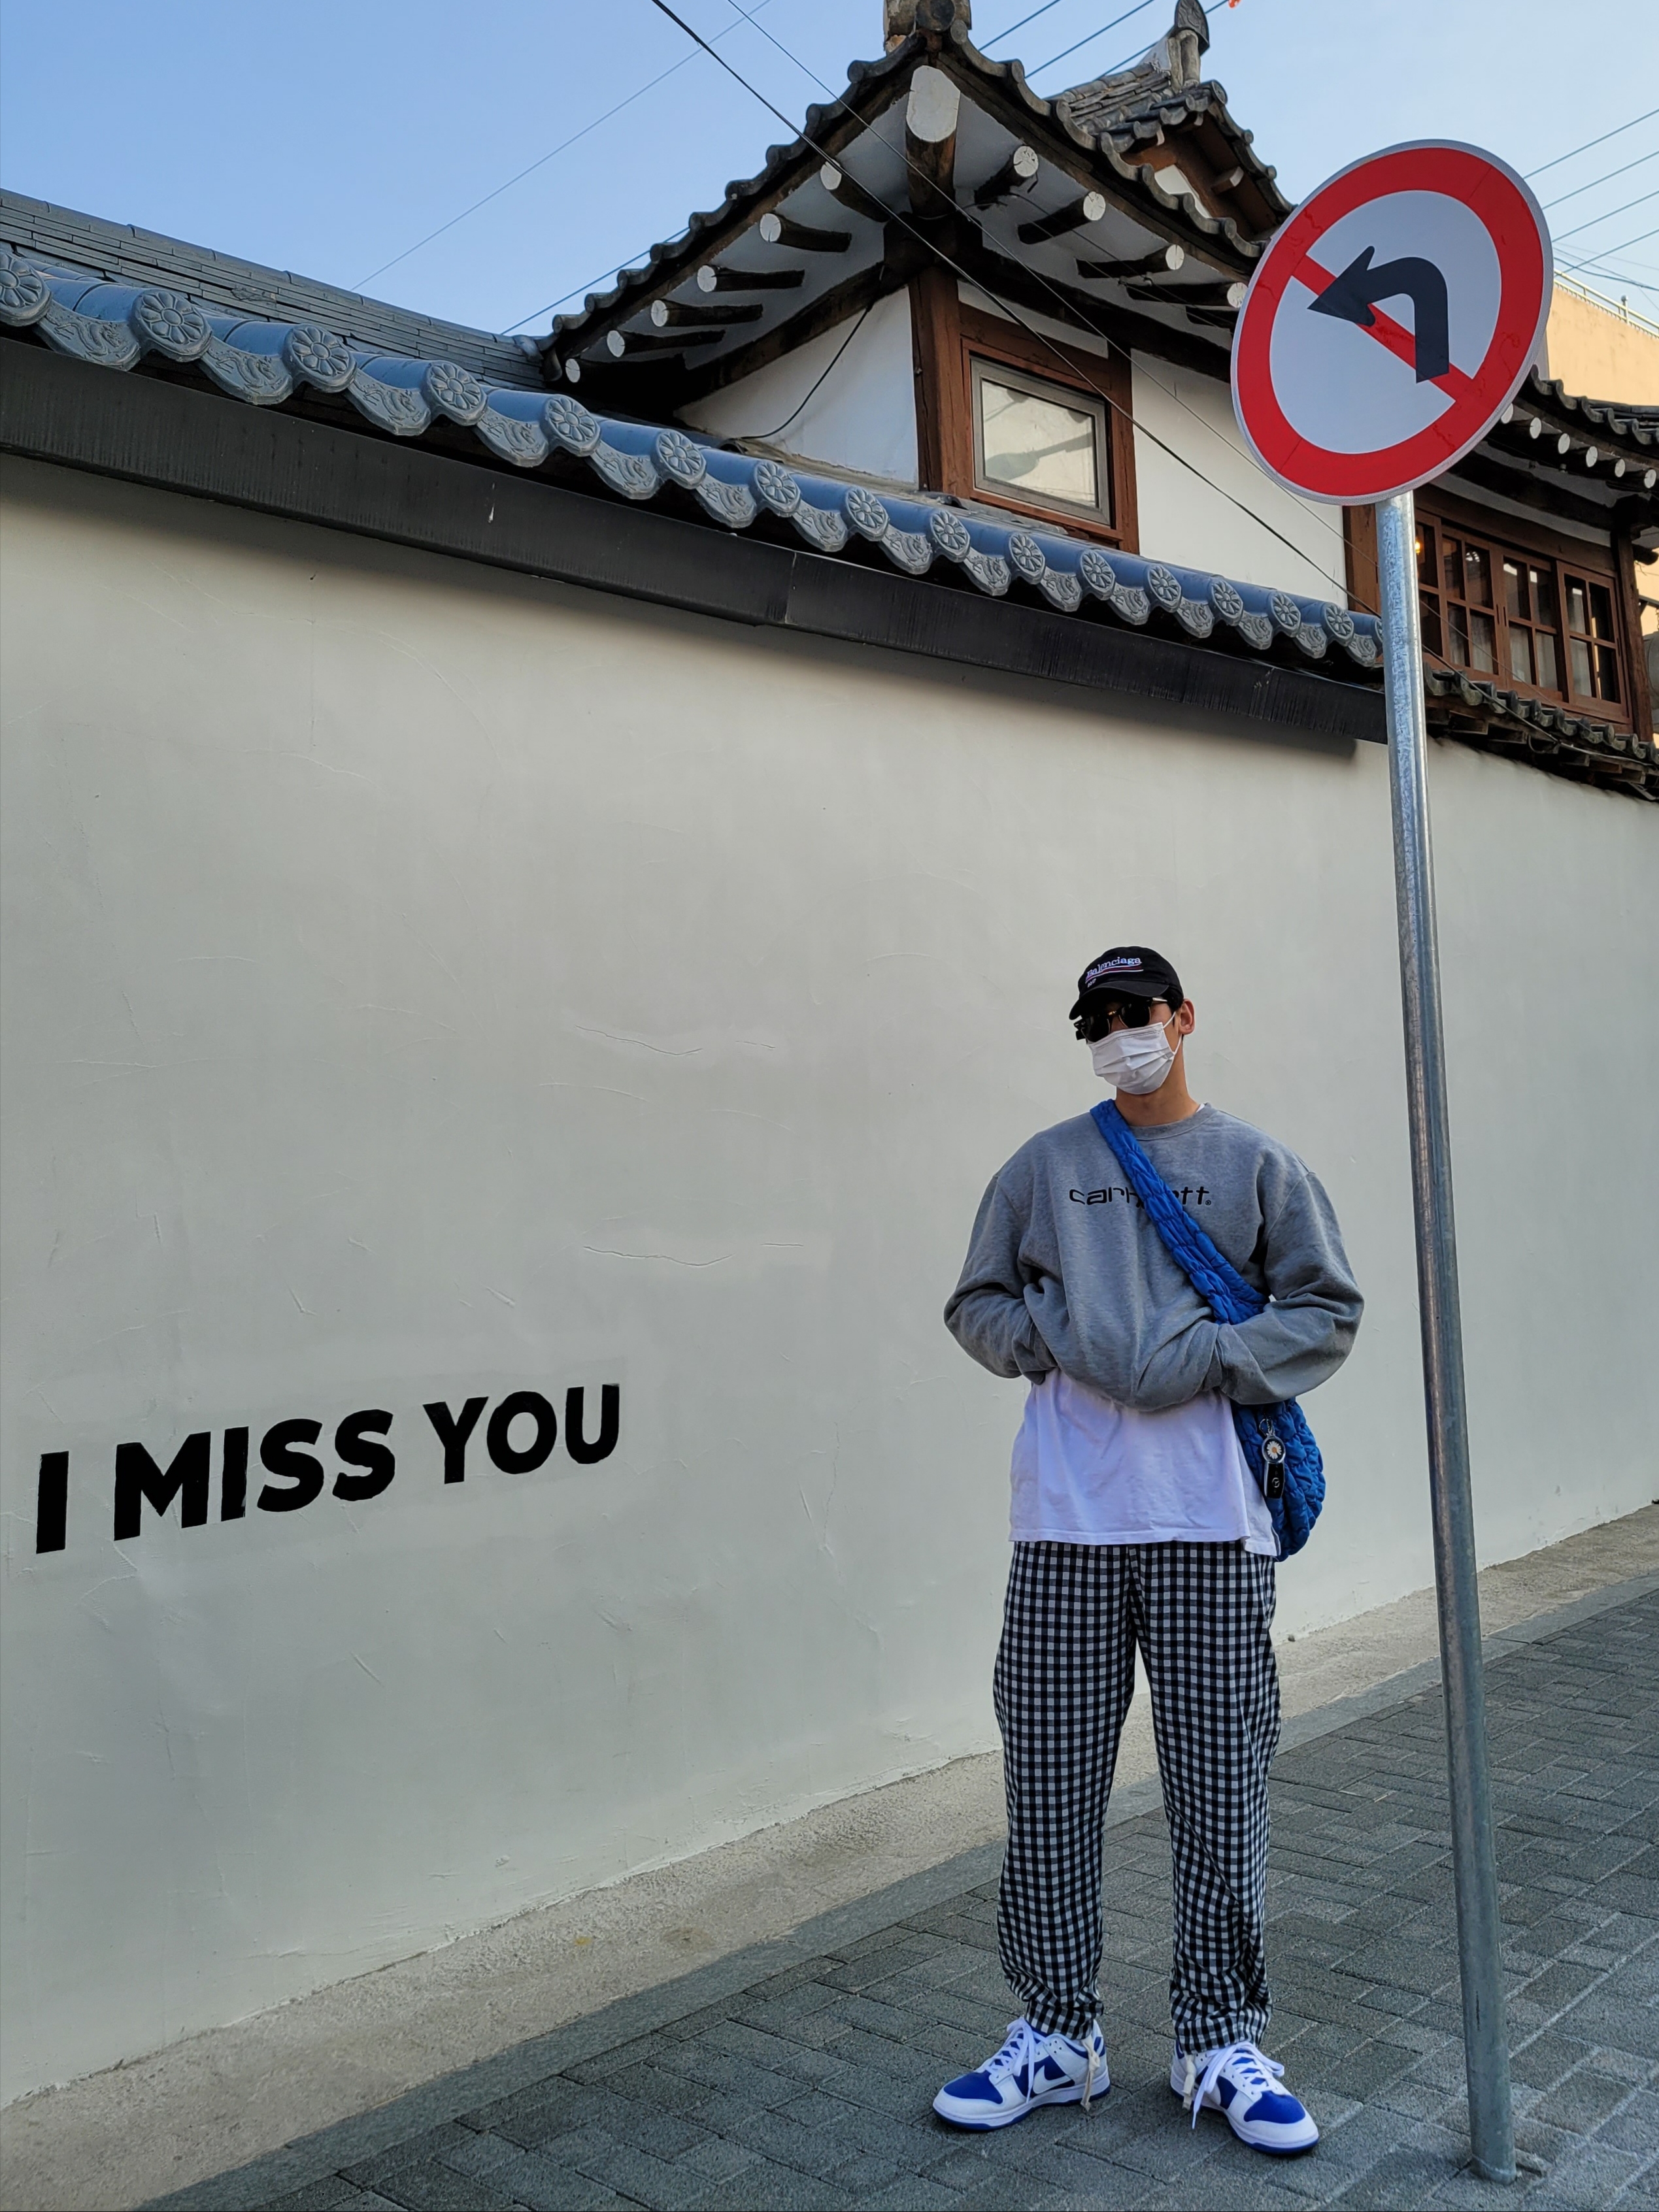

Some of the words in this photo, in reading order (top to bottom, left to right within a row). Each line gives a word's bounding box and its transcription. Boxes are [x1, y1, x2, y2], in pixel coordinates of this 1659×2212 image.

[1069, 1186, 1210, 1208] carhtt
[36, 1451, 69, 1554] I
[114, 1409, 395, 1541] MISS
[423, 1384, 620, 1484] YOU
